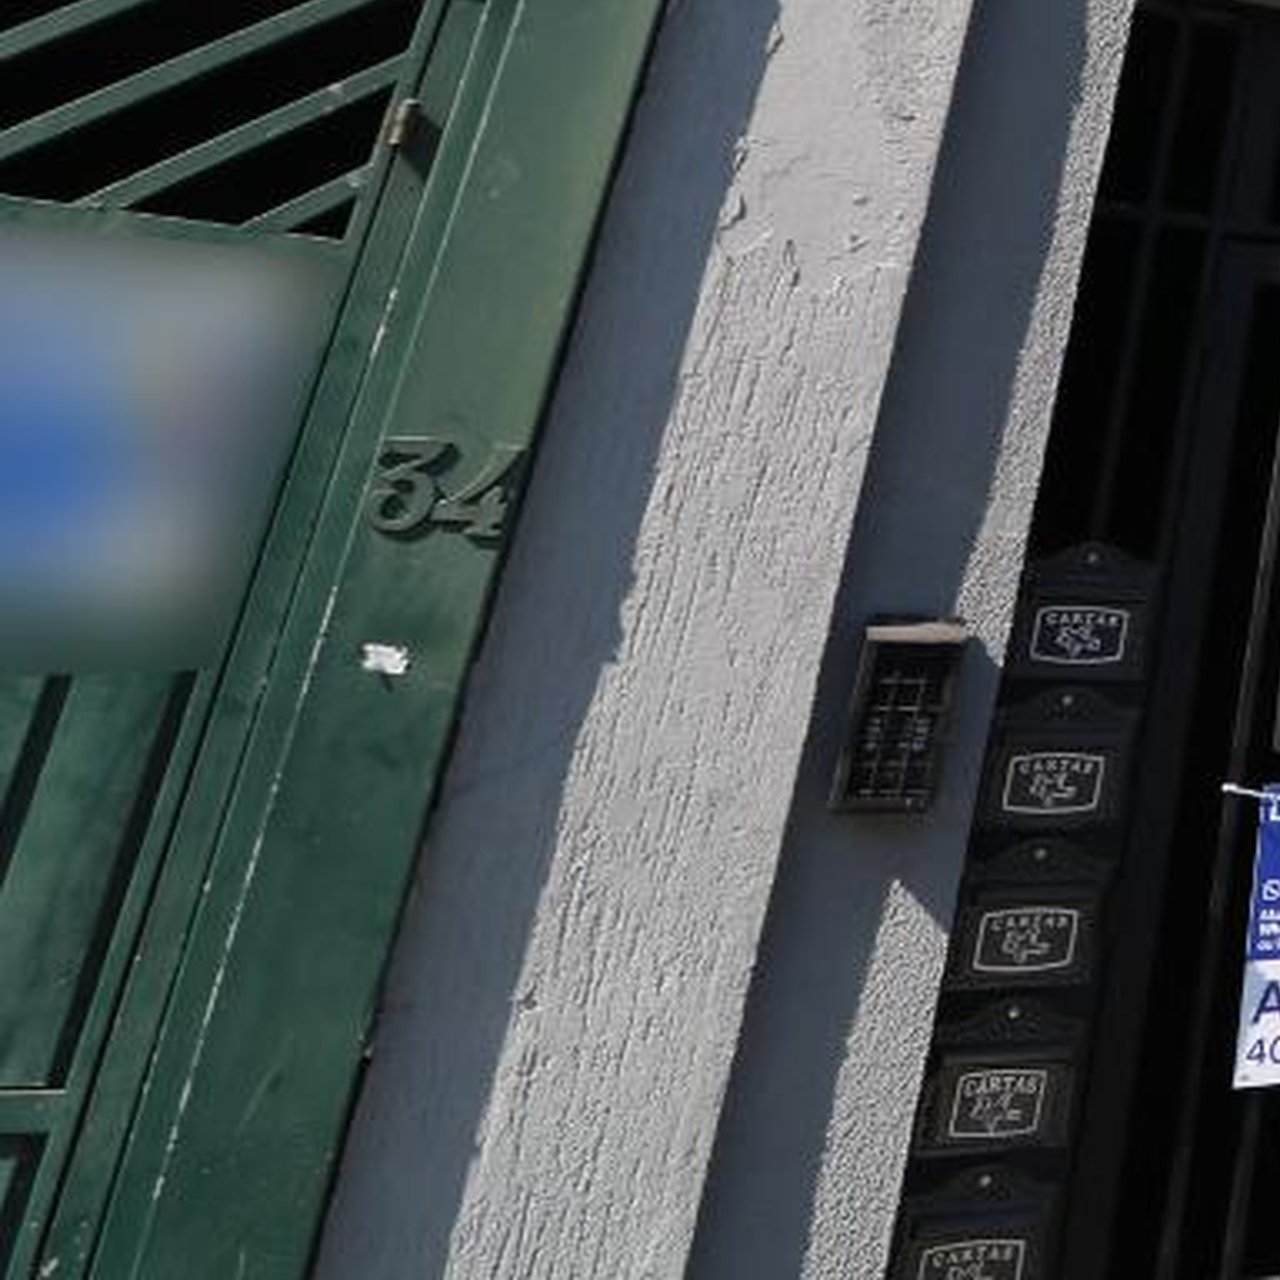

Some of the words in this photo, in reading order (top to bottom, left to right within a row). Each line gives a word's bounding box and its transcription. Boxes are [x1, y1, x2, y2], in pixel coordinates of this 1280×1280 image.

[369, 435, 526, 546] 34
[1046, 612, 1119, 626] CARTAS
[1019, 759, 1093, 774] CARTAS
[991, 915, 1068, 931] CARTAS
[965, 1075, 1037, 1097] CARTAS
[932, 1246, 1013, 1268] CARTAS
